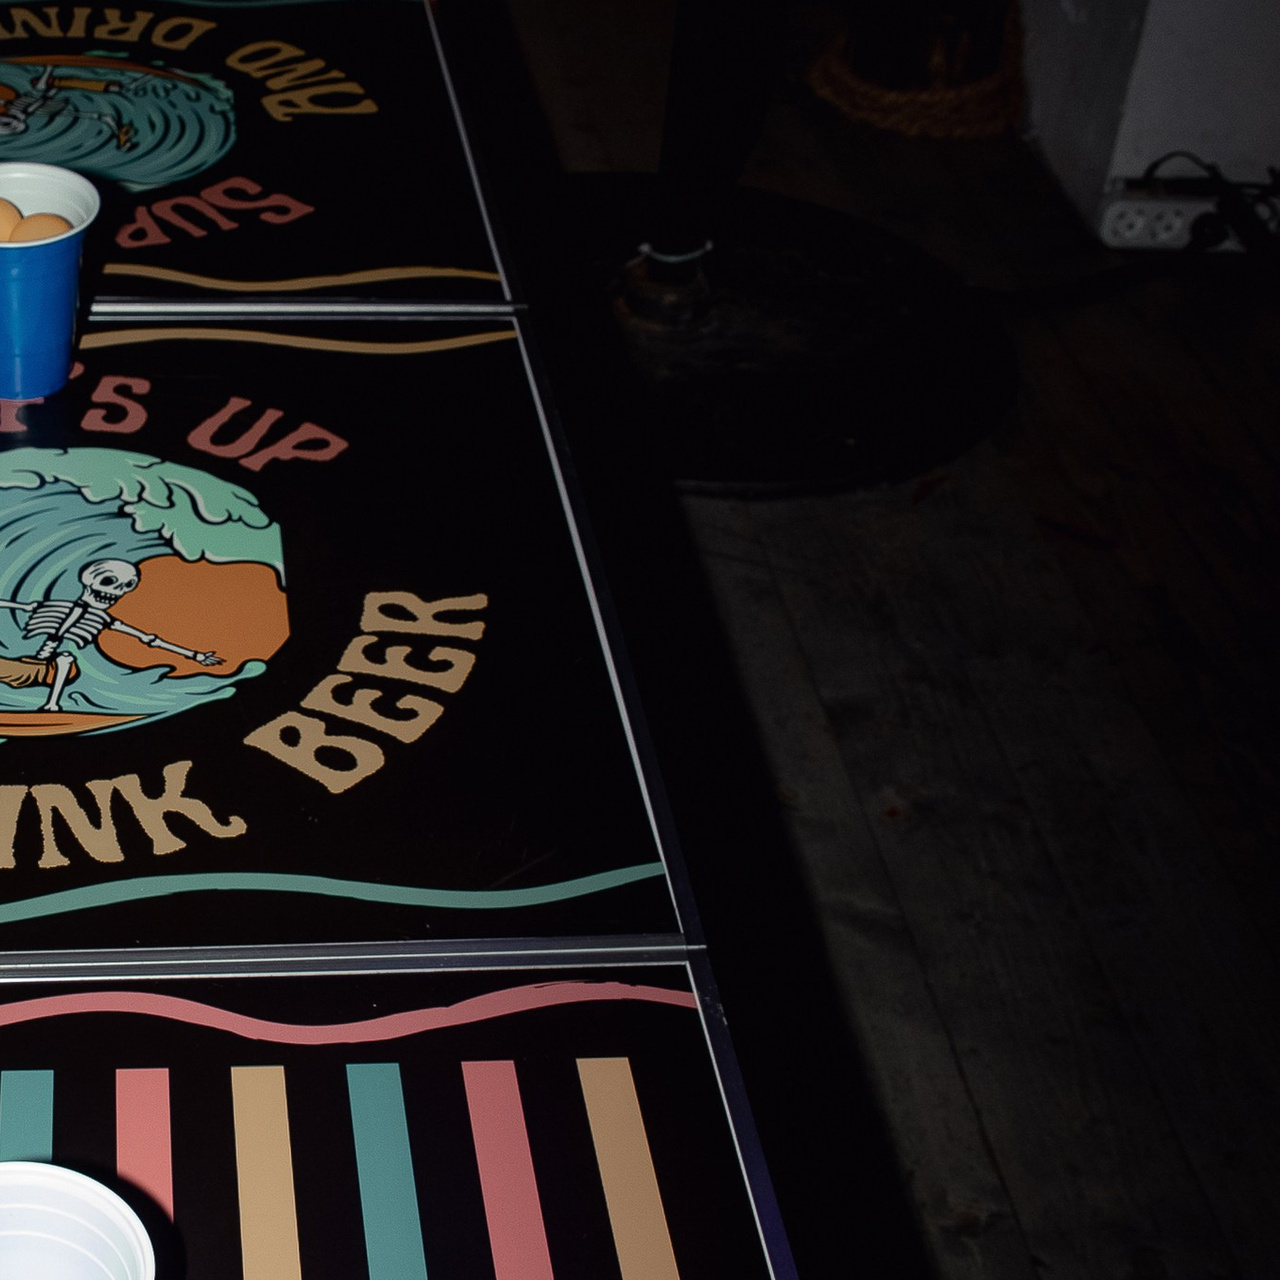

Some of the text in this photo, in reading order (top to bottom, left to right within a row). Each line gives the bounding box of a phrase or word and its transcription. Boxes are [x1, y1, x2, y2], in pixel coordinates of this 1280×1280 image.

[225, 40, 379, 122] AND
[186, 395, 350, 473] UP
[243, 590, 489, 794] BEER
